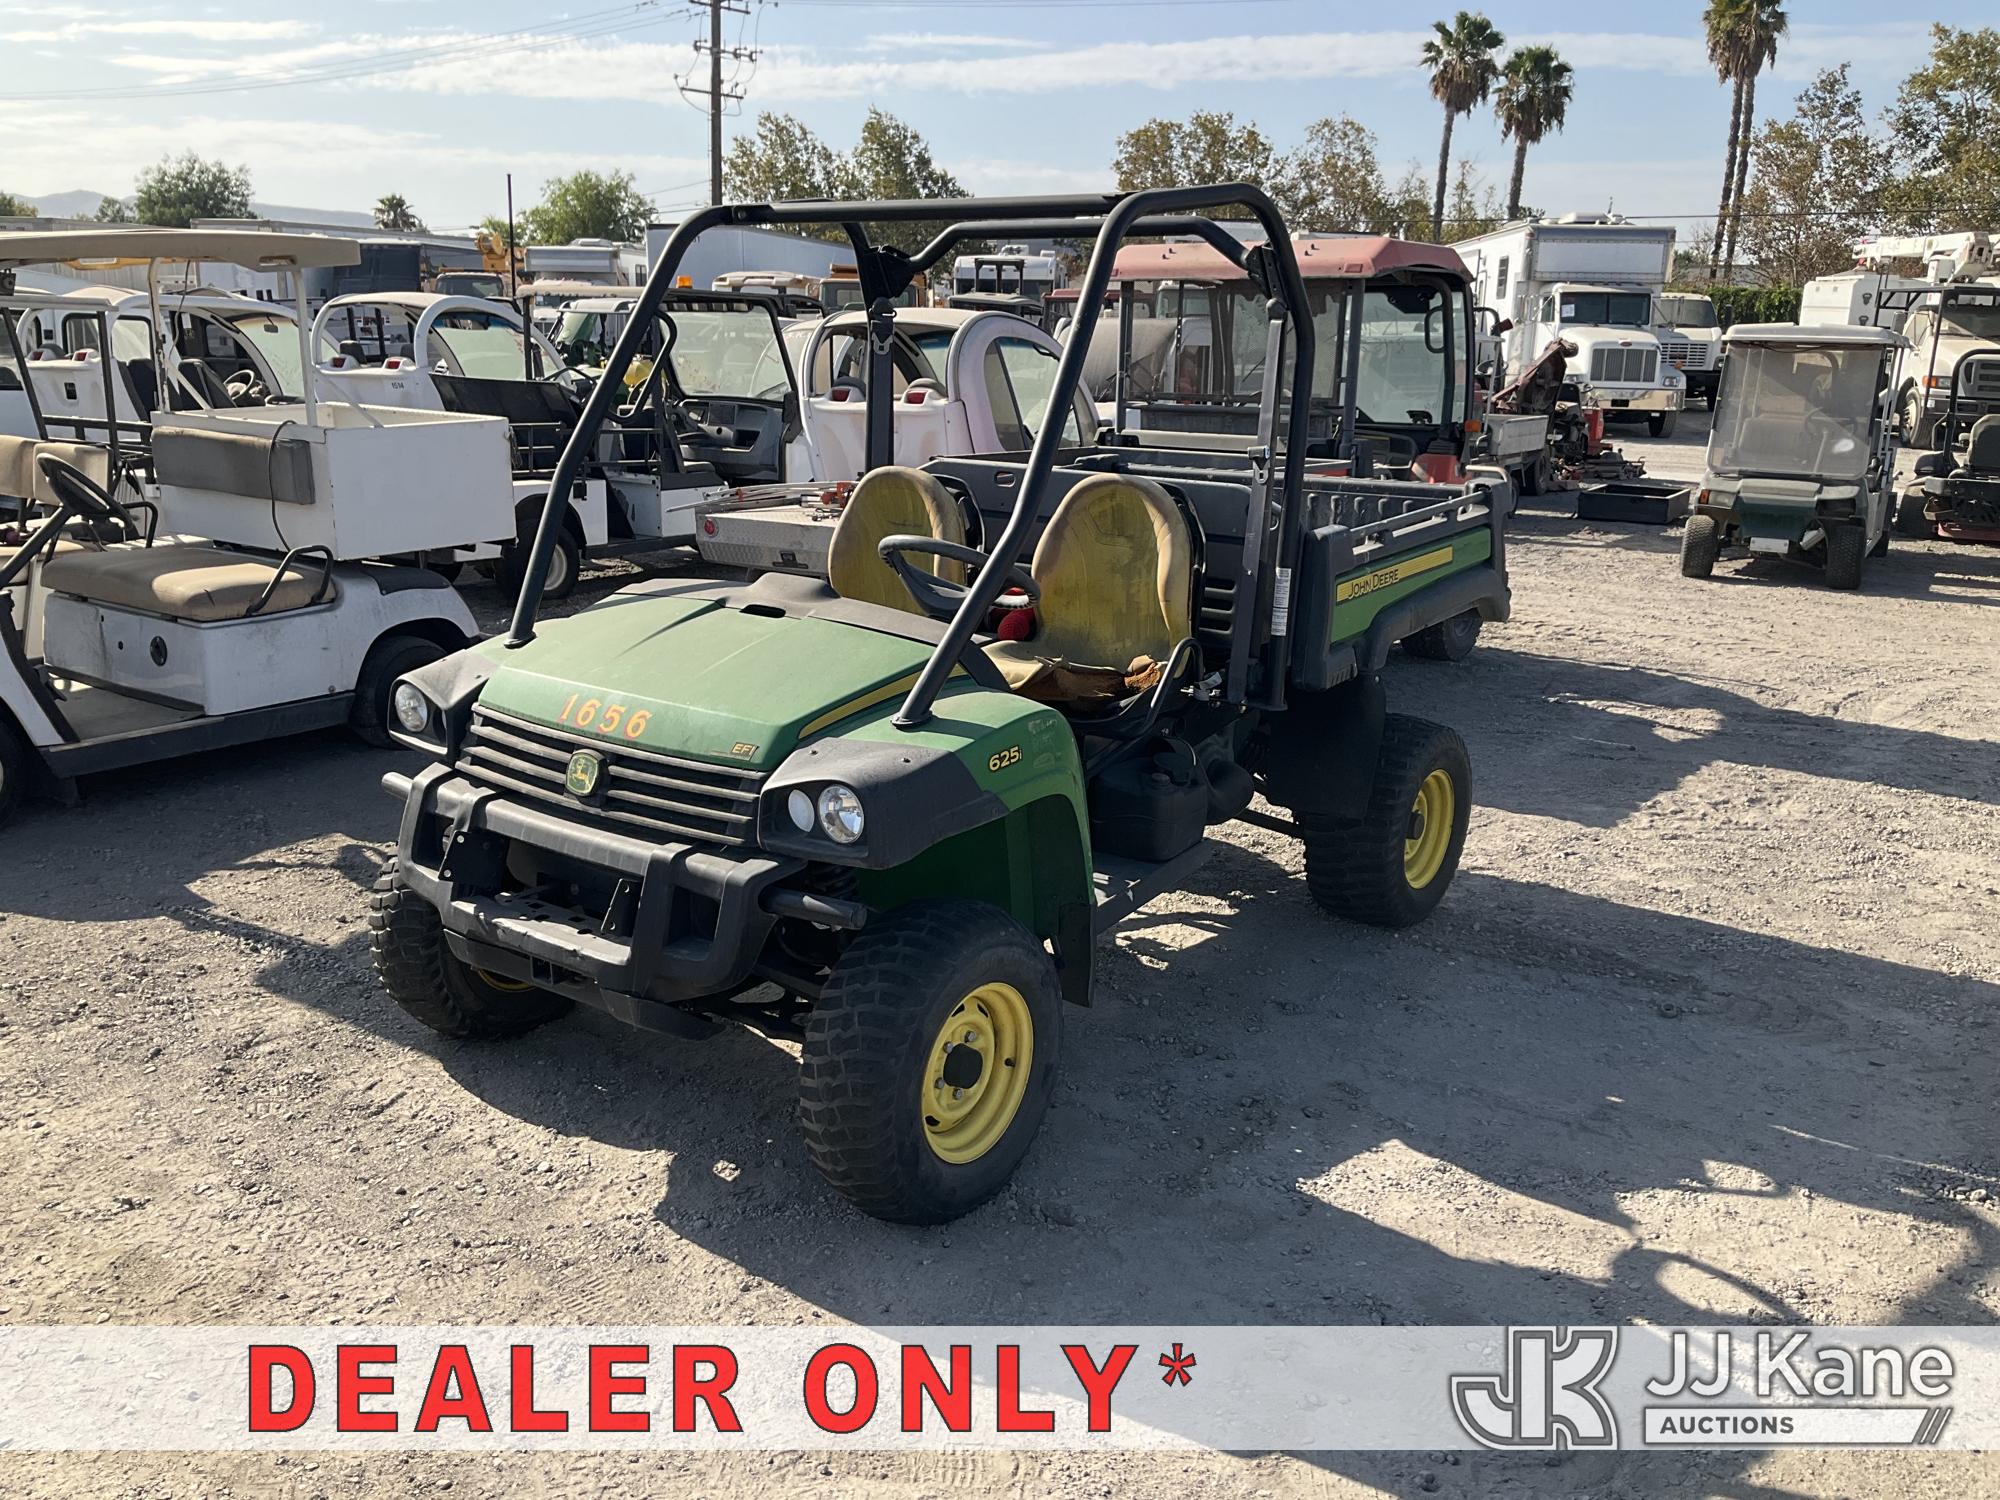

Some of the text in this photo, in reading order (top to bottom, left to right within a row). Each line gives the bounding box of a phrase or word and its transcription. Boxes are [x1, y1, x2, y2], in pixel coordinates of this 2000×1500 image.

[1348, 569, 1399, 598] JOHN DEERE
[557, 693, 653, 740] 1656
[731, 743, 756, 756] EFI
[988, 745, 1022, 772] 625i
